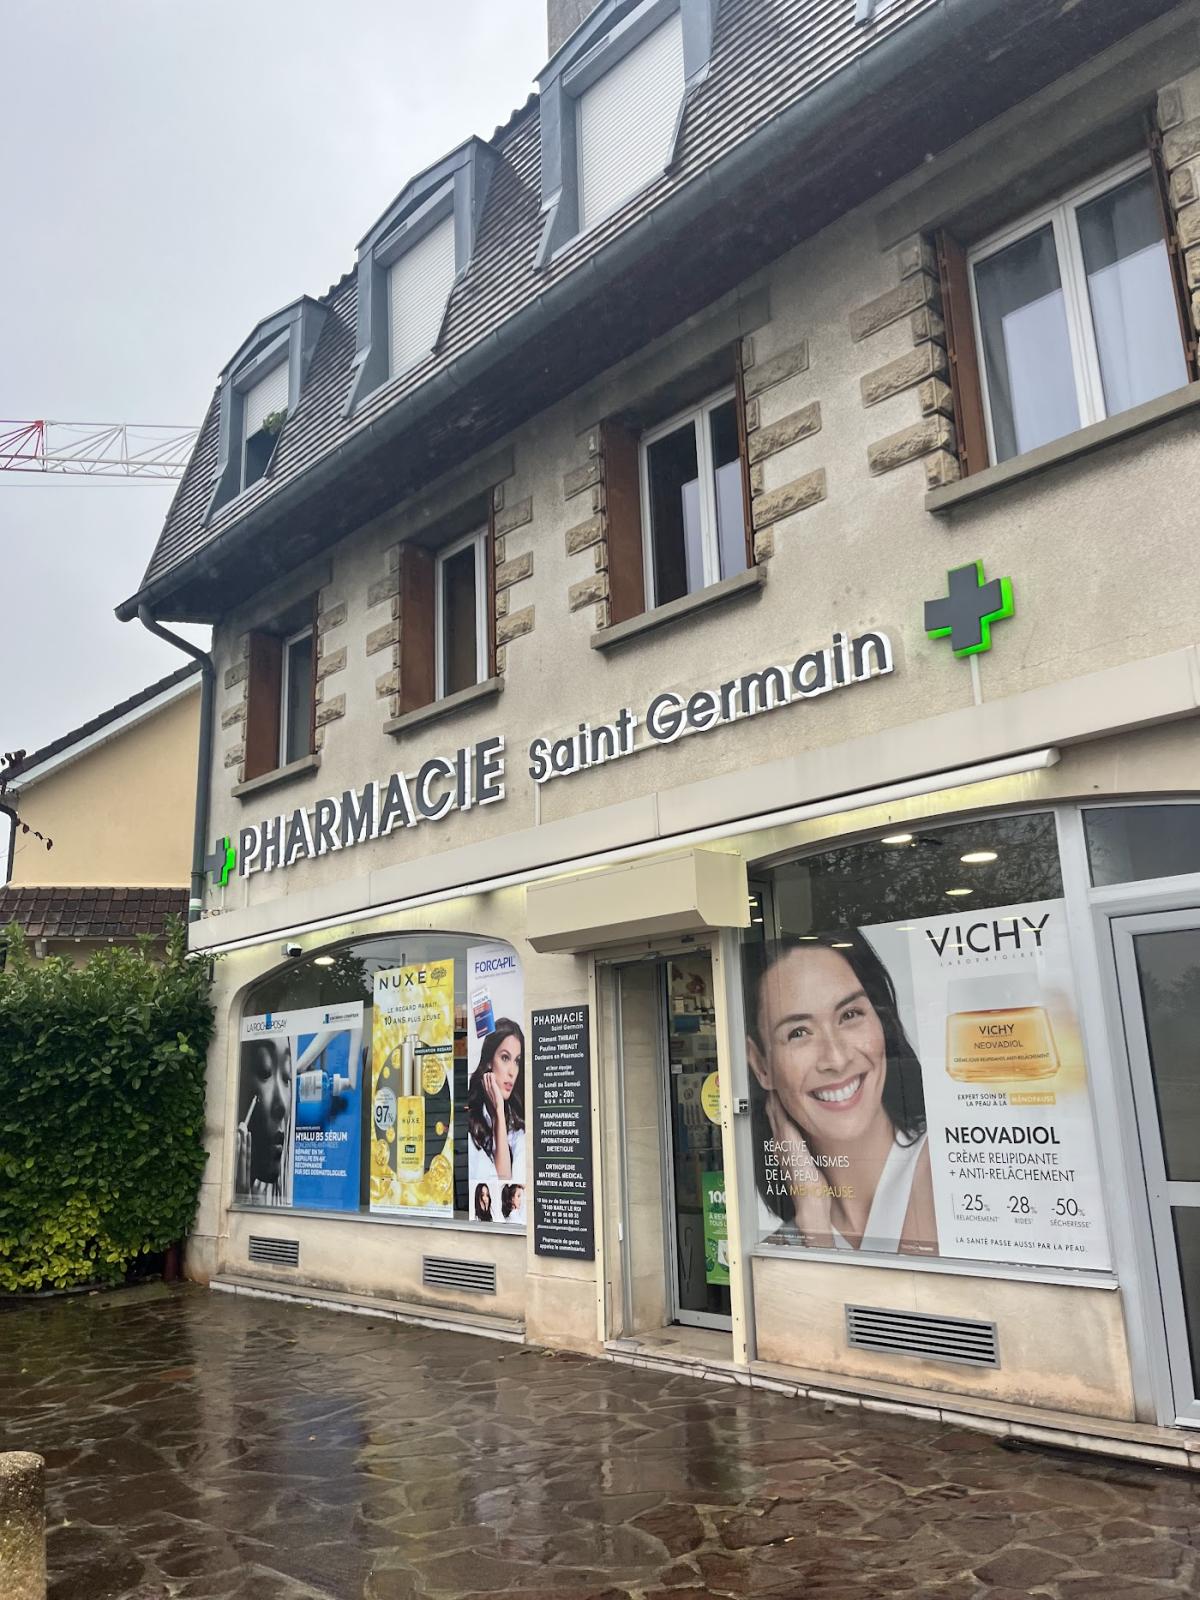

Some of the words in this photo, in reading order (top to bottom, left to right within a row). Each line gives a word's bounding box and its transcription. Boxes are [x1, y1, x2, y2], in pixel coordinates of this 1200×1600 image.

[239, 735, 505, 878] PHARMACIE
[528, 707, 638, 783] Saint
[646, 631, 894, 744] Germain
[925, 913, 1050, 957] VICHY
[474, 956, 516, 974] FORCAPIL
[379, 970, 427, 990] NUXE
[384, 1015, 392, 1025] 10
[533, 1011, 584, 1025] PHARMACIE
[979, 1024, 1015, 1035] VICHY
[974, 1040, 1024, 1050] NEOVADIOL
[295, 1132, 315, 1141] HYALU
[324, 1129, 348, 1142] SÉRUM
[945, 1126, 1061, 1145] NEOVADIOL
[763, 1137, 806, 1152] RÉACTIVE
[764, 1154, 779, 1167] LES
[781, 1152, 850, 1168] MÉCANISMES
[948, 1149, 986, 1164] CRÈME
[988, 1152, 1059, 1166] RELIPIDANTE
[765, 1169, 778, 1181] DE
[780, 1170, 792, 1181] LA
[794, 1171, 819, 1183] PEAU
[959, 1165, 1075, 1182] ANTI-RELÂCHEMENT
[766, 1181, 774, 1196] À
[775, 1184, 788, 1196] LA
[990, 1239, 1012, 1247] PASSE
[1037, 1242, 1051, 1250] PAR
